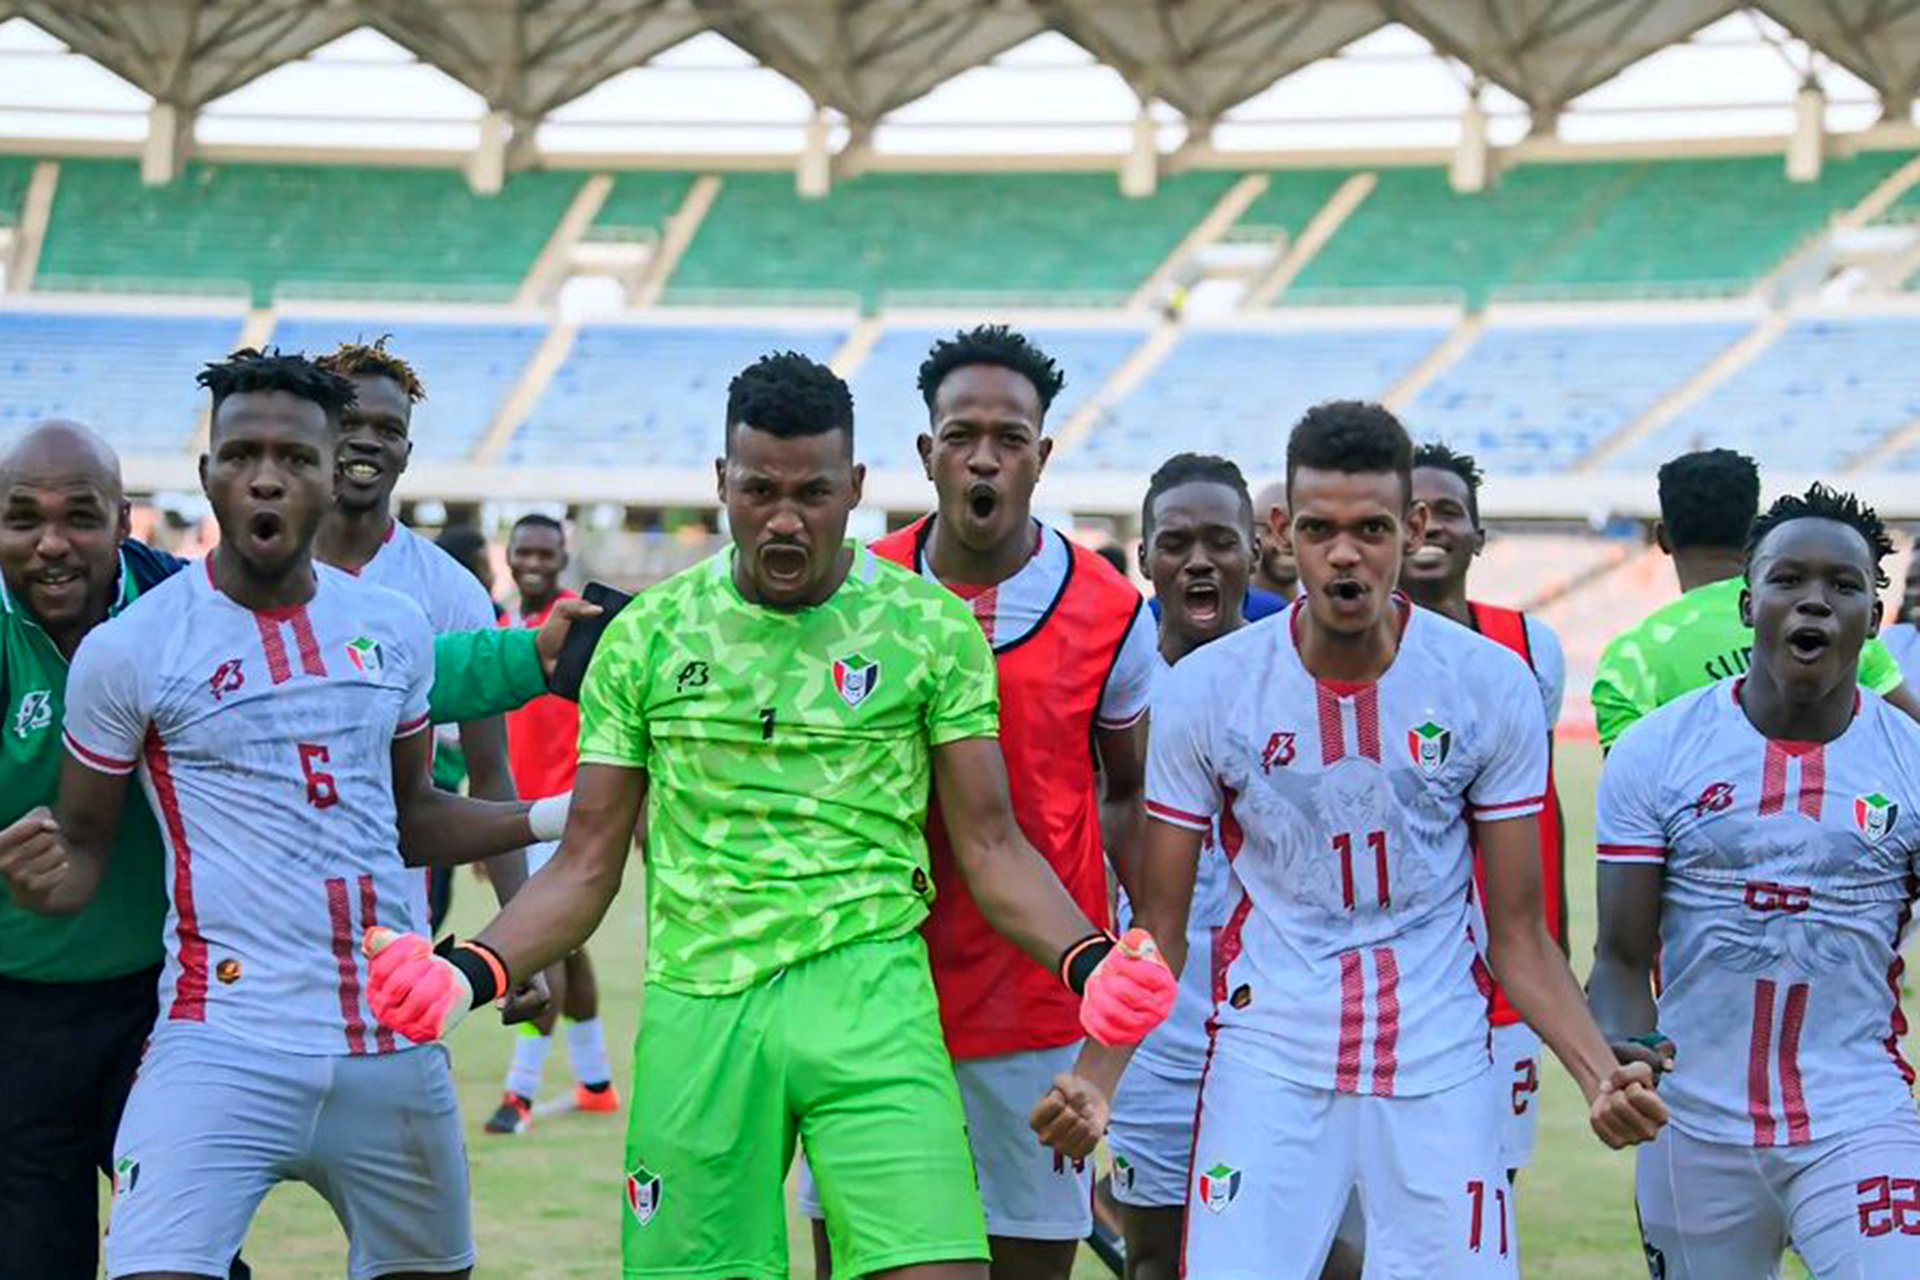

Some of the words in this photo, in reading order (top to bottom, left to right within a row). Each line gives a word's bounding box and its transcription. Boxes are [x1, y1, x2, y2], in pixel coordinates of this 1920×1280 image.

[297, 743, 338, 809] 6
[1332, 831, 1391, 911] 11
[1467, 1181, 1507, 1258] 11
[1856, 1175, 1920, 1237] 22
